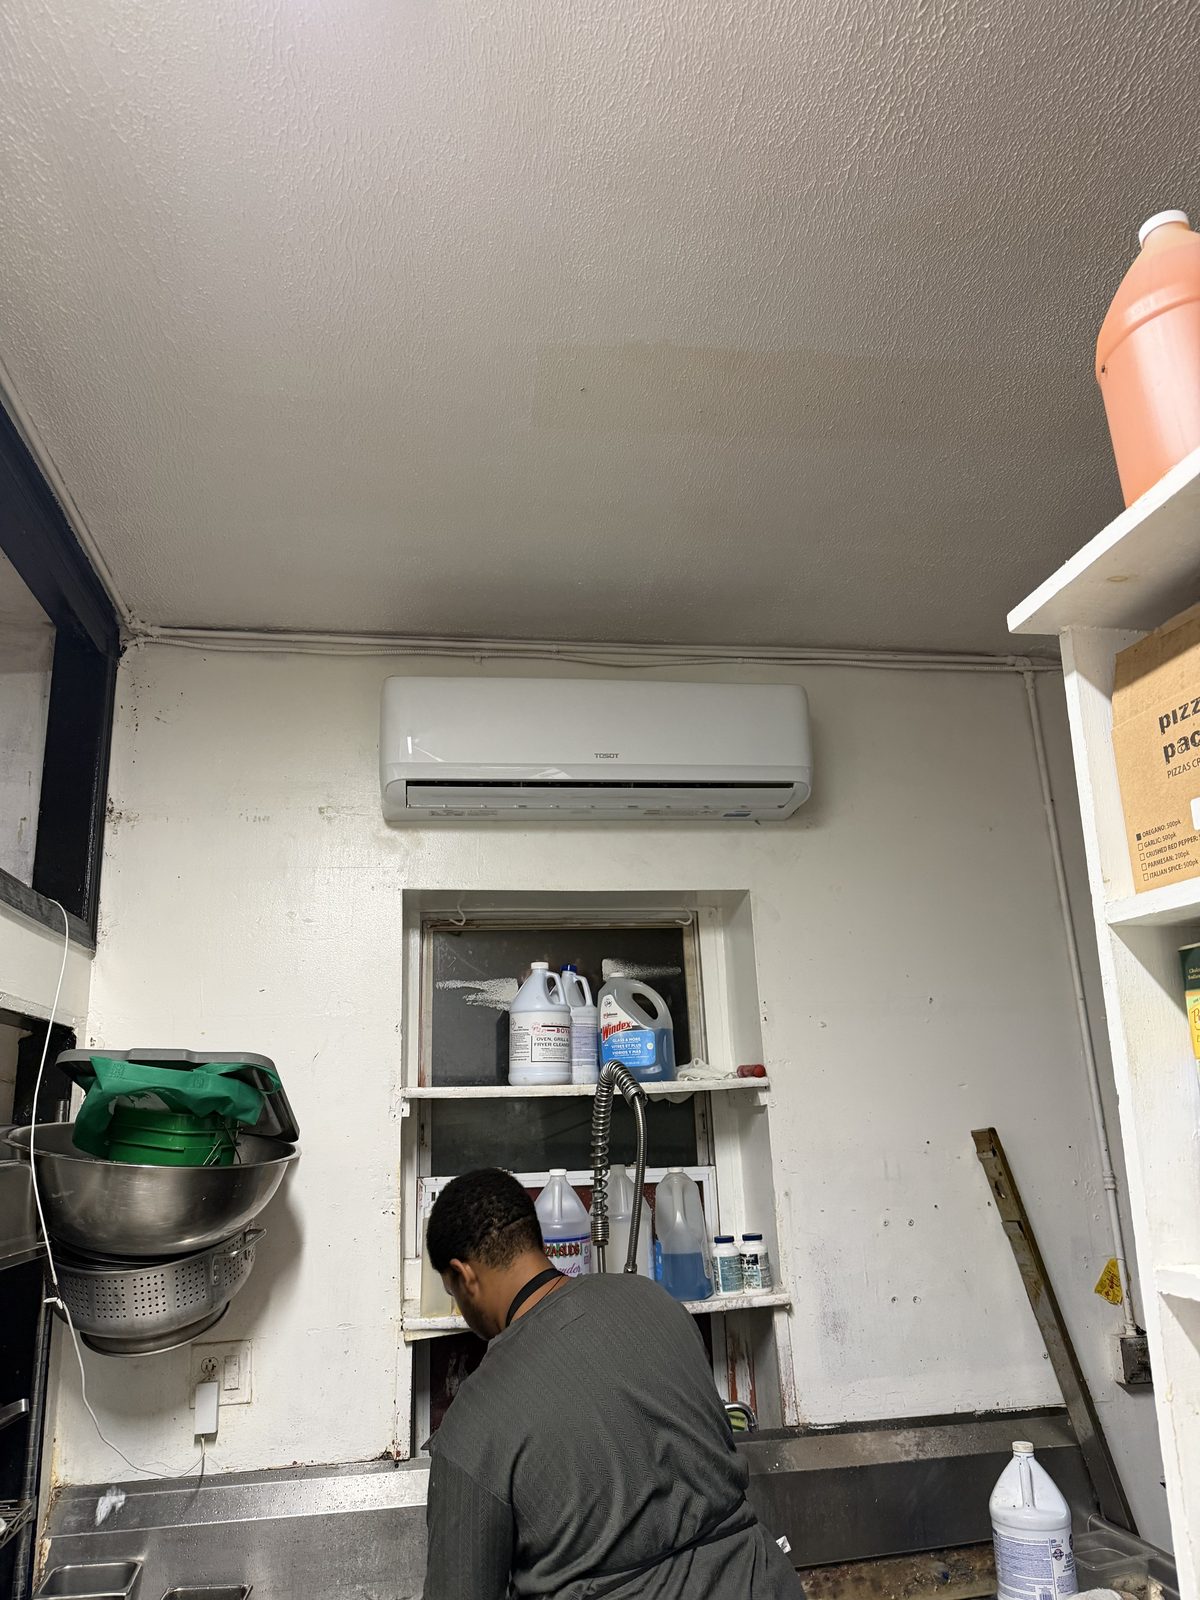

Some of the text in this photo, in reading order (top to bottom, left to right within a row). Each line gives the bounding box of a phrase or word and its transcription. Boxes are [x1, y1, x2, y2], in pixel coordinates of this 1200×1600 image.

[1167, 762, 1191, 779] PIZZAS
[1142, 819, 1181, 837] OREGANO: 500pk
[1162, 832, 1176, 841] 500pk
[1146, 835, 1198, 858] CRUSHED RED PEPPER:
[1147, 855, 1174, 868] PARMESAN:
[1150, 859, 1199, 880] ITALIAN SPICE: 500pk
[602, 1020, 631, 1042] Windex
